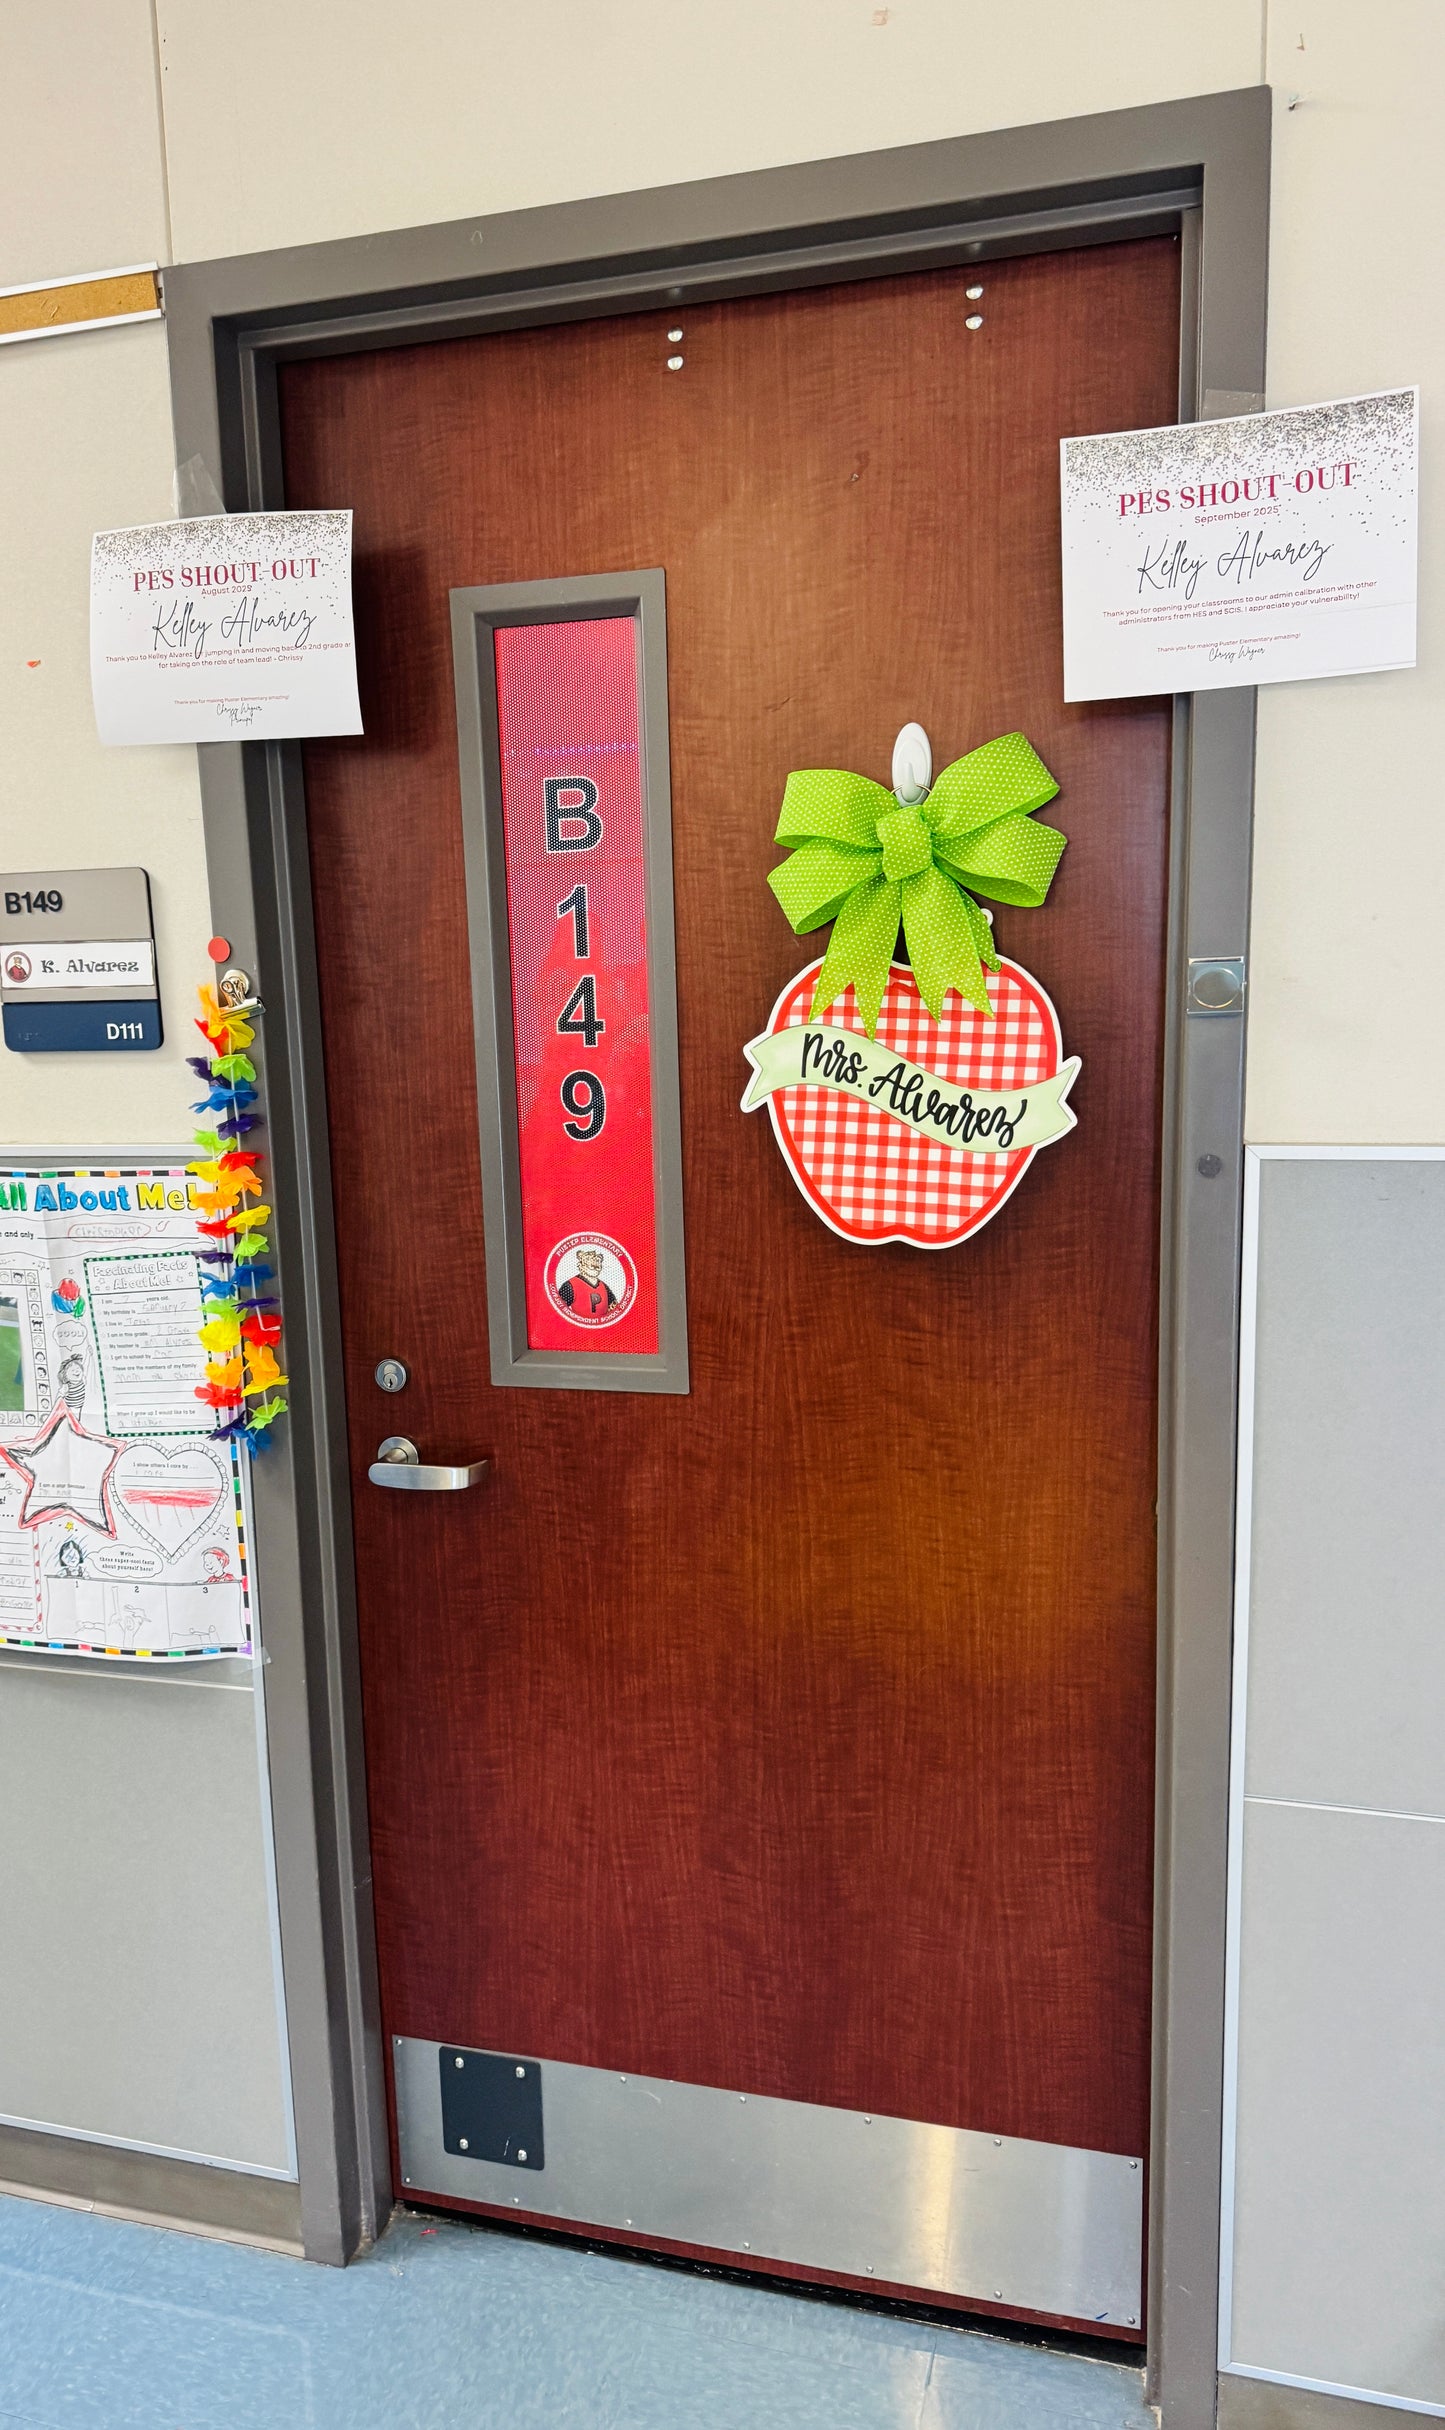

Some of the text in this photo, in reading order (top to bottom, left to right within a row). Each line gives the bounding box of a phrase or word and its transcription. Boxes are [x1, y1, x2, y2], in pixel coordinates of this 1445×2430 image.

[1118, 462, 1358, 517] PES SHOUT-OUT
[1194, 505, 1279, 524] September 2025
[133, 557, 321, 592] PES SHOUT-OUT
[1137, 530, 1332, 600] Kelley Alvarez
[201, 587, 230, 596] August
[1126, 609, 1139, 617] you
[1152, 604, 1182, 613] opening
[1183, 602, 1200, 611] your
[1201, 597, 1244, 608] classrooms
[1269, 591, 1293, 600] admin
[1294, 586, 1336, 597] calibration
[1337, 583, 1354, 591] with
[1355, 580, 1377, 589] other
[1118, 615, 1172, 626] administrators
[1173, 612, 1191, 620] from
[1248, 602, 1290, 613] appreciate
[1291, 600, 1309, 609] your
[1309, 593, 1360, 605] vulnerability!
[152, 596, 317, 660] Kelley Alvarez
[1239, 636, 1273, 645] Elementary
[126, 655, 139, 664] you
[204, 648, 232, 658] jumping
[255, 646, 281, 654] moving
[322, 642, 343, 650] grade
[169, 661, 191, 669] taking
[277, 654, 303, 662] Chrissy
[4, 889, 63, 914] B149
[40, 958, 140, 974] K. Alvarez
[106, 1022, 144, 1041] D111
[800, 1032, 1028, 1148] Mrs. Alvarez
[34, 1181, 132, 1212] About
[4, 1230, 18, 1238] and
[20, 1231, 34, 1240] only
[93, 1260, 188, 1277] Fascinating Facts
[113, 1275, 171, 1290] About Me!
[590, 1293, 602, 1313] P
